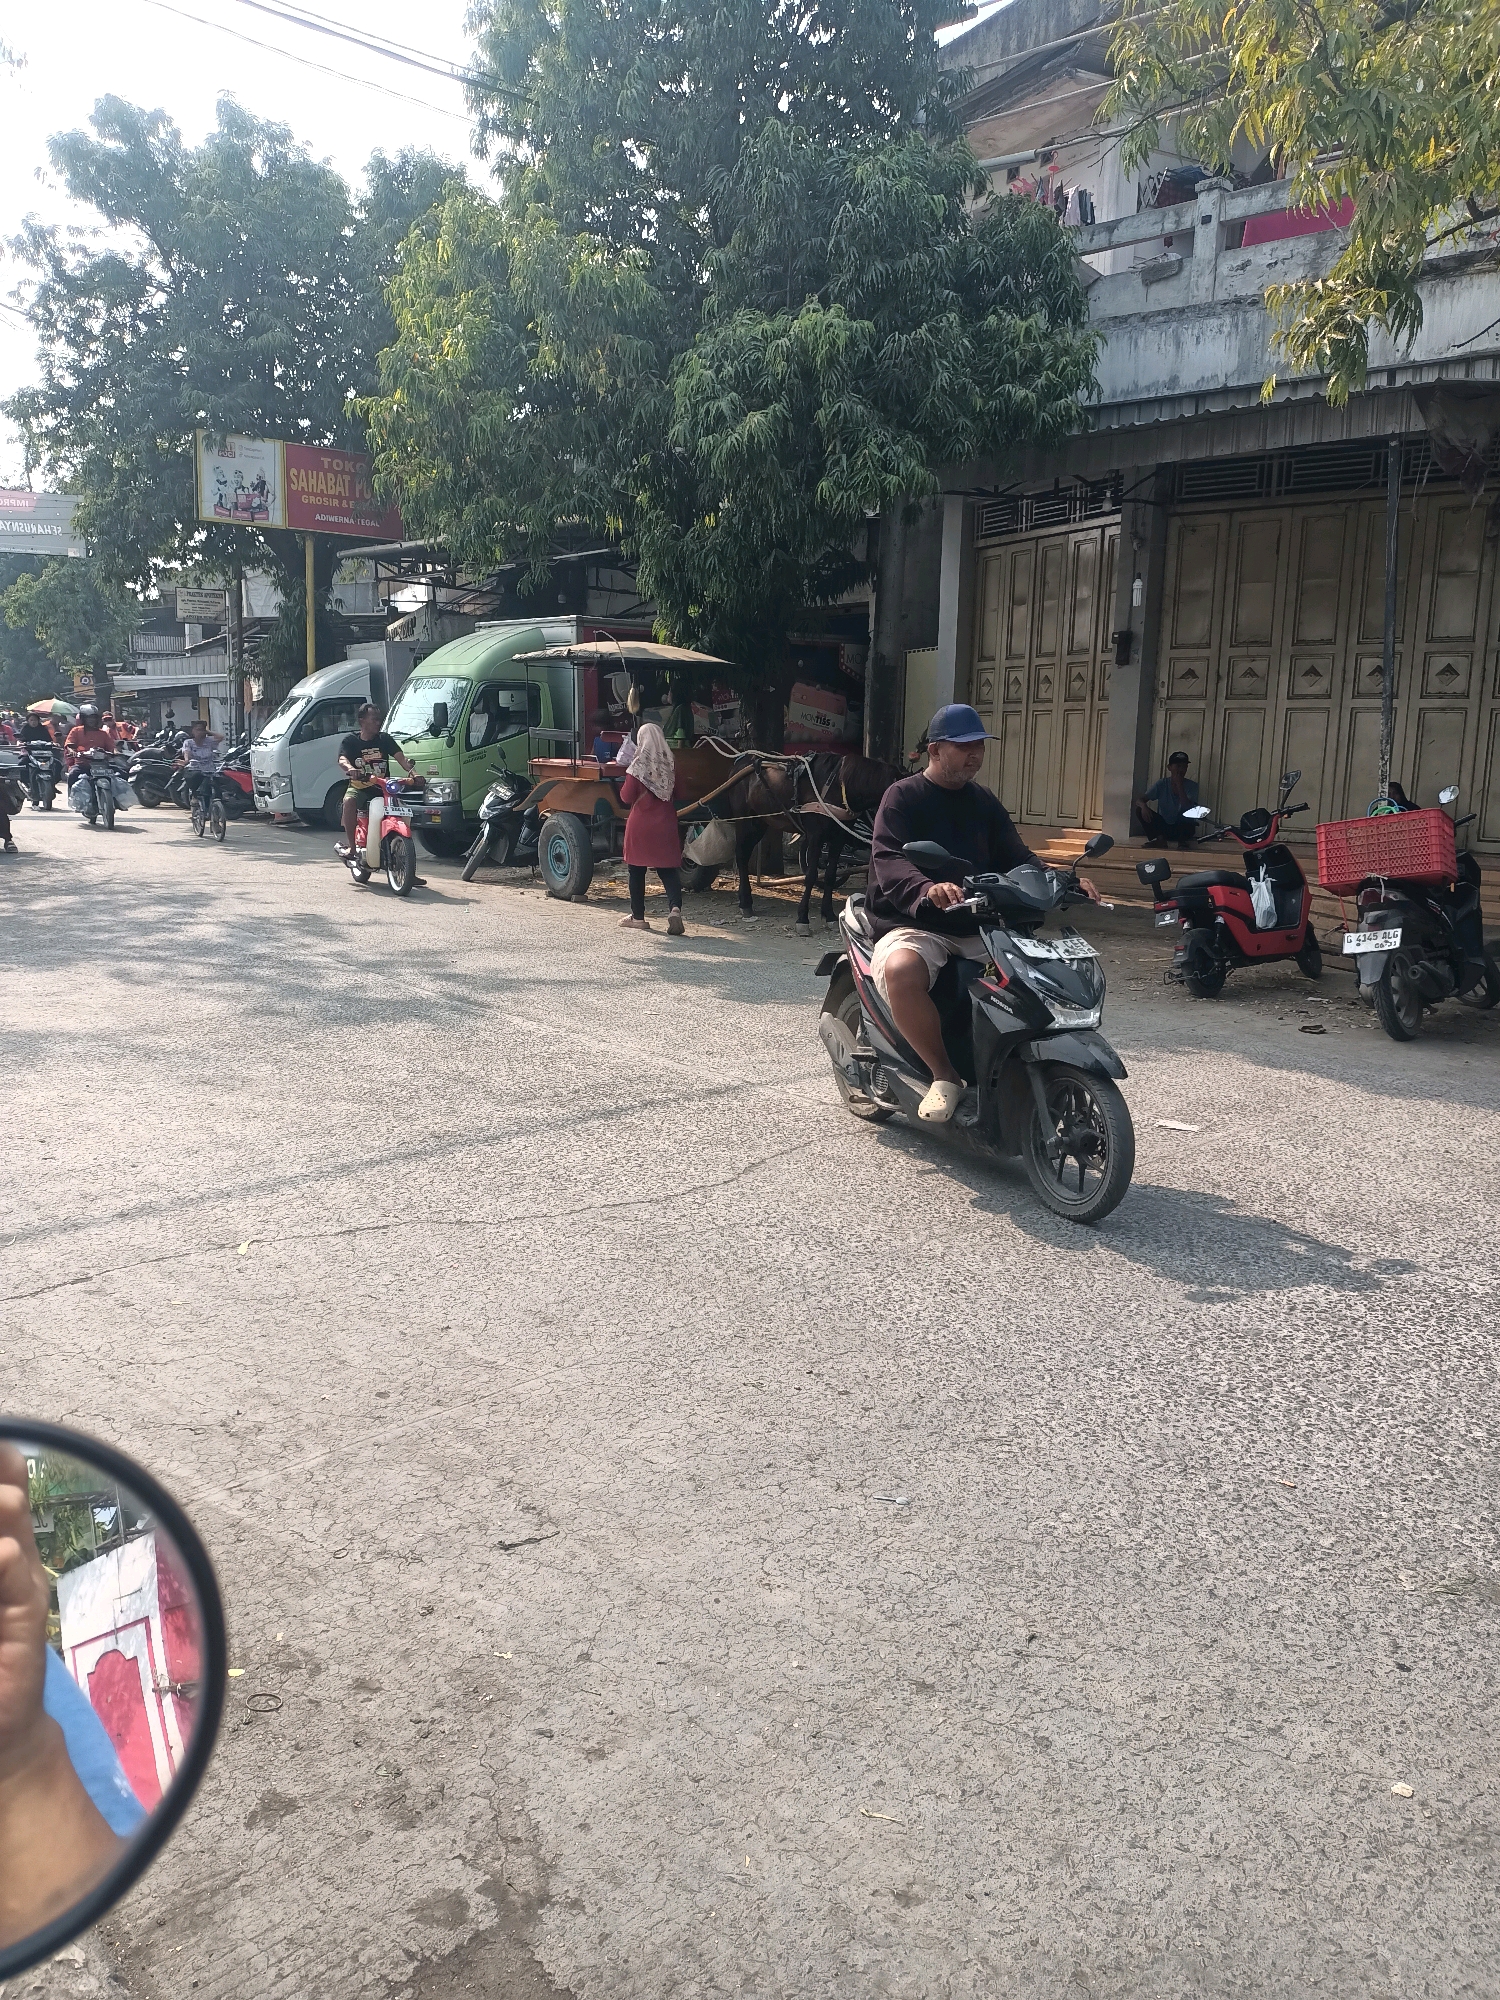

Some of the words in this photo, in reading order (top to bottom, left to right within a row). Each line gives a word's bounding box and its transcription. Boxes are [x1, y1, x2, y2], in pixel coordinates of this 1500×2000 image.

[320, 457, 367, 474] TOKO
[289, 467, 350, 497] SAHABAT
[301, 494, 339, 508] GROSIR
[341, 499, 348, 508] &
[800, 711, 831, 726] MONTISS
[1346, 935, 1353, 944] G
[1356, 932, 1378, 943] 4145
[1381, 930, 1399, 939] ALG
[990, 995, 1014, 1015] HONDA
